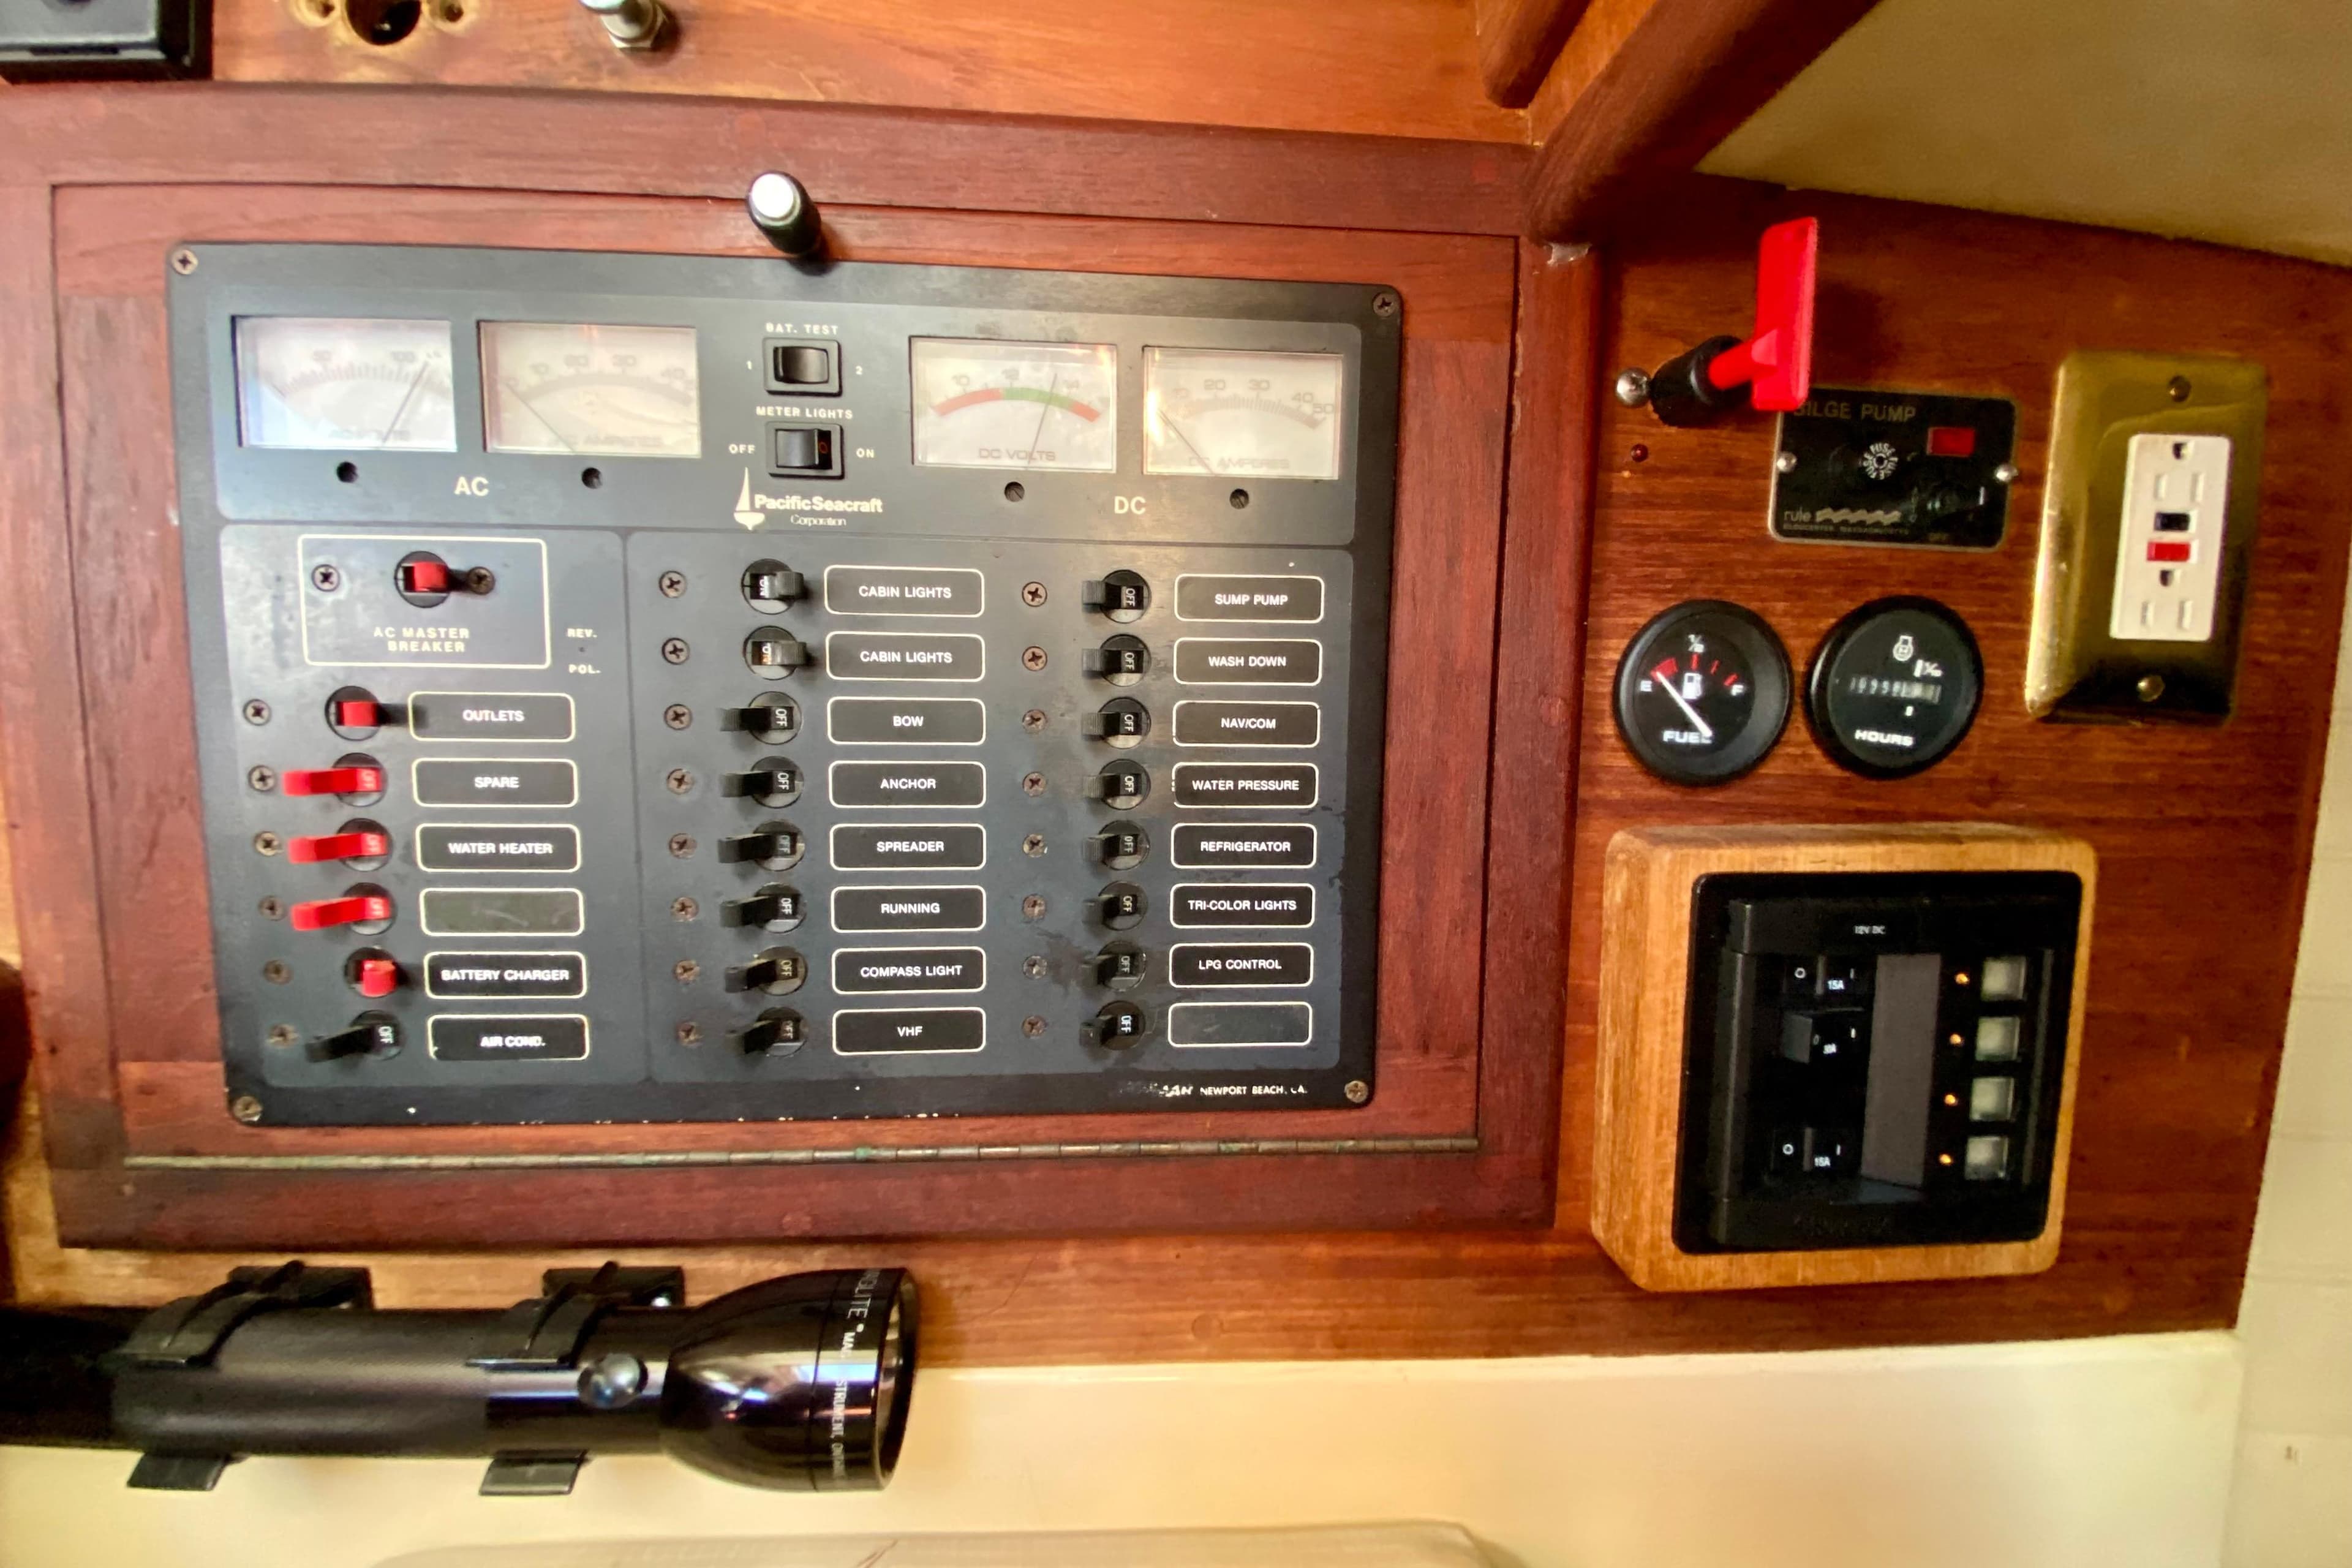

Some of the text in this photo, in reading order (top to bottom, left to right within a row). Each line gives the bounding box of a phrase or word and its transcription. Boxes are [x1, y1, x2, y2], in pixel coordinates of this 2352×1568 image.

[766, 323, 838, 335] BAT. TEST
[747, 360, 752, 370] 1
[856, 366, 863, 375] 2
[952, 374, 970, 388] 10
[1204, 379, 1226, 391] 20
[1248, 379, 1270, 391] 30
[1291, 392, 1314, 404] 40
[756, 406, 853, 420] METER LIGHTS
[1312, 402, 1335, 414] 50
[1861, 403, 1917, 423] PUMP
[729, 443, 755, 454] OFF
[856, 448, 874, 458] ON
[979, 448, 1002, 459] DC
[454, 477, 489, 497] AC
[1114, 497, 1145, 514] DC
[791, 514, 846, 527] Corporation
[859, 586, 952, 598] CABIN LIGHTS
[1126, 588, 1136, 607] OFF
[1215, 594, 1288, 605] SUMP PUMP
[374, 627, 469, 639] AC MASTER
[567, 628, 597, 638] REV.
[388, 641, 465, 652] BREAKER
[860, 651, 952, 663] CABIN LIGHTS
[1125, 652, 1134, 671] OFF
[1208, 656, 1286, 667] WASH DOWN
[570, 665, 601, 674] POL.
[1641, 680, 1653, 692] E
[1731, 684, 1744, 696] F
[463, 710, 524, 722] OUTLETS
[775, 708, 788, 727] OFF
[893, 715, 924, 727] BOW
[1125, 714, 1134, 732] OFF
[1221, 718, 1276, 729] NAV/COM
[1662, 729, 1713, 744] FUEL
[1855, 729, 1913, 747] HOURS
[475, 777, 519, 788] SPARE
[777, 772, 790, 790] OFF
[881, 778, 937, 790] ANCHOR
[1125, 775, 1134, 793] OFF
[1193, 780, 1300, 791] WATER PRESSURE
[448, 843, 552, 854] WATER HEATER
[877, 841, 944, 852] SPREADER
[1124, 835, 1133, 853] OFF
[1200, 842, 1291, 852] REFRIGERATOR
[781, 897, 793, 914] OFF
[881, 903, 940, 914] RUNNING
[1123, 895, 1133, 913] OFF
[1188, 900, 1297, 911] TRI-COLOR LIGHTS
[781, 960, 793, 976] OFF
[1121, 956, 1130, 974] OFF
[1199, 959, 1282, 970] LPG CONTROL
[442, 970, 569, 981] BATTERY CHARGER
[861, 965, 962, 978] COMPASS LIGHT
[1121, 1016, 1132, 1034] OFF
[897, 1026, 922, 1037] VHF
[480, 1035, 545, 1047] AIR COND.
[1200, 1086, 1247, 1095] NEWPORT
